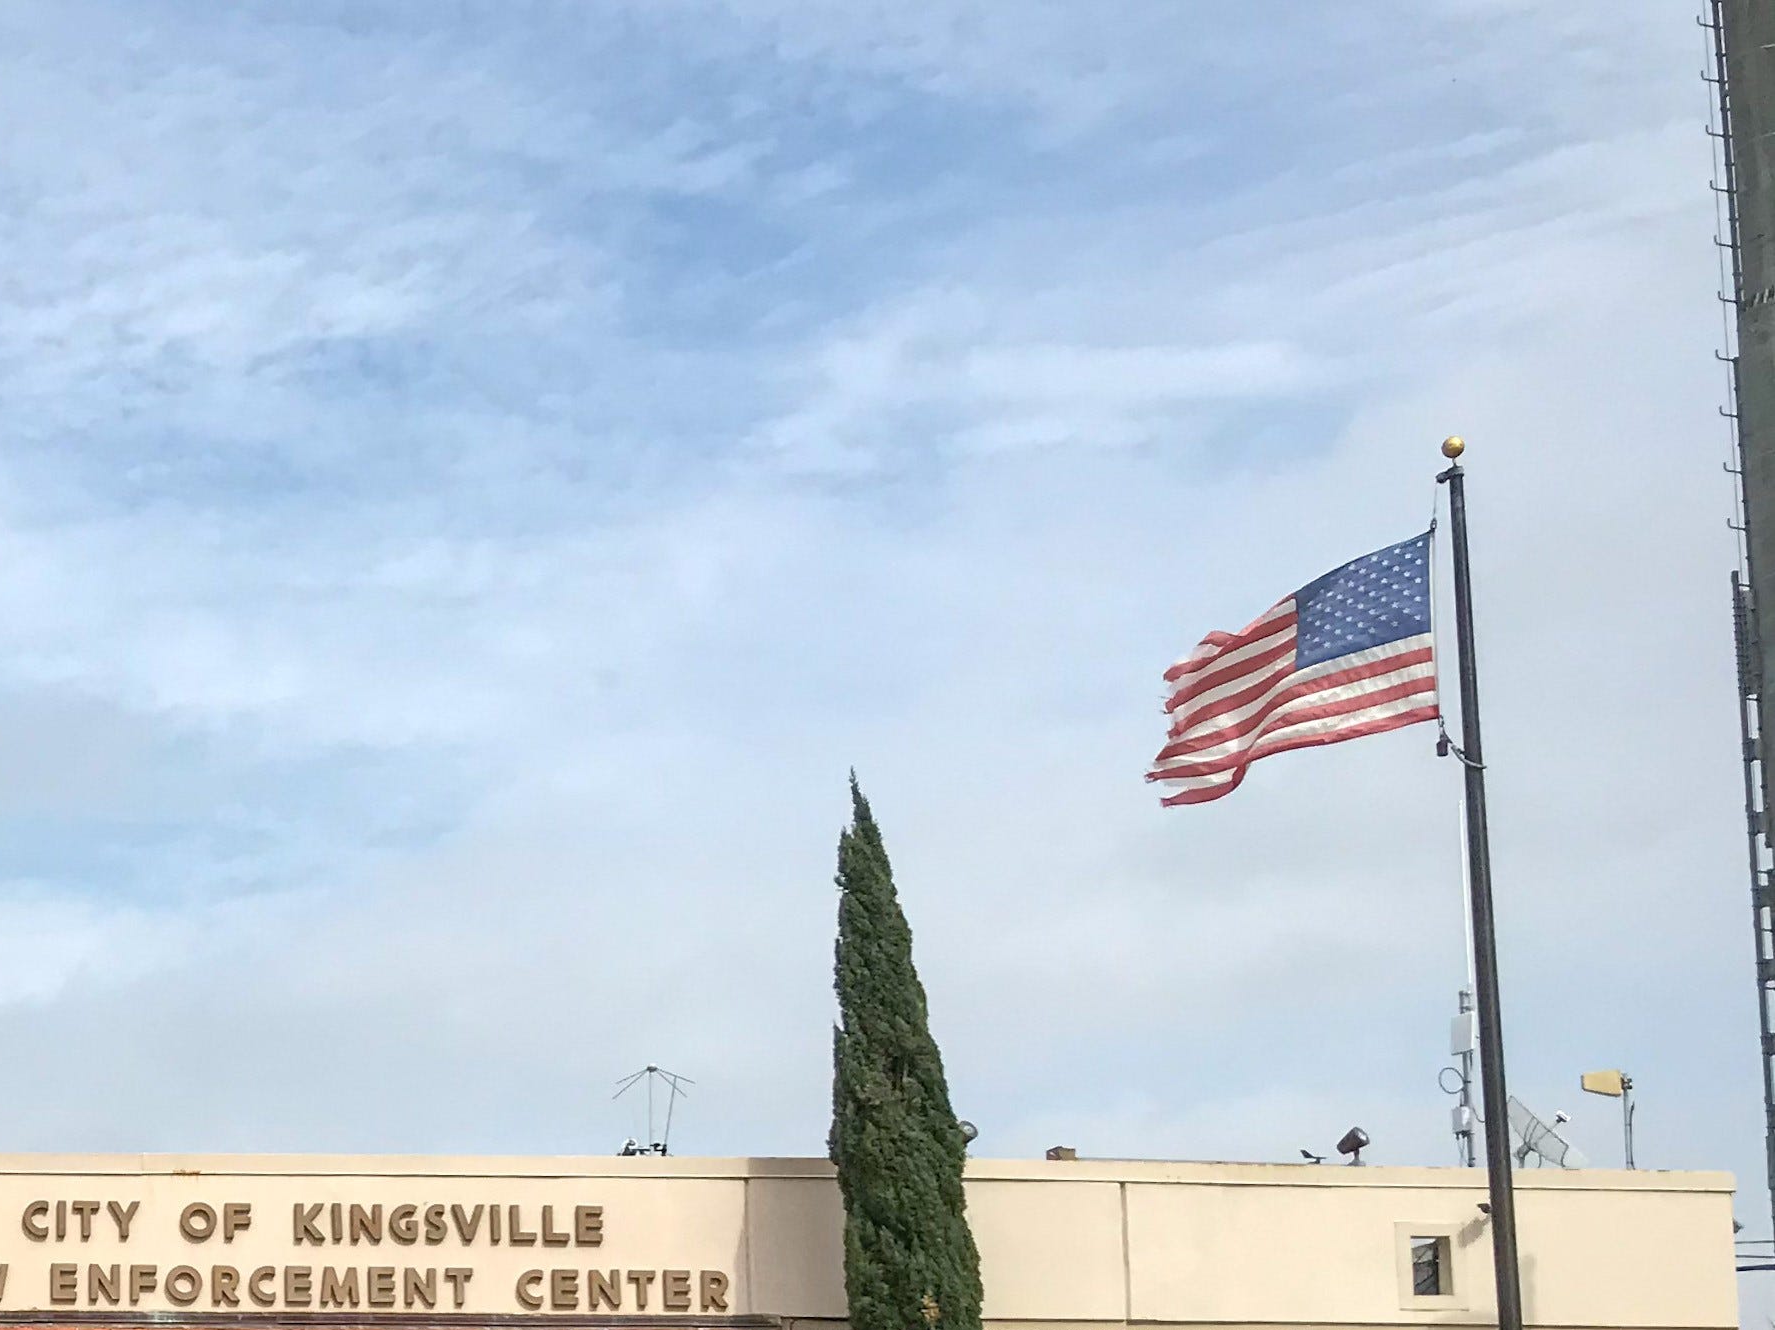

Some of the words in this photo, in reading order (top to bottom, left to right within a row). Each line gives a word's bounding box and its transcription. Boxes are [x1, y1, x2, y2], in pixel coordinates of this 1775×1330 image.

[23, 1200, 140, 1243] CITY
[179, 1202, 252, 1244] OF
[293, 1202, 604, 1247] KINGSVILLE
[50, 1263, 474, 1309] ENFORCEMENT
[516, 1269, 730, 1312] CENTER
